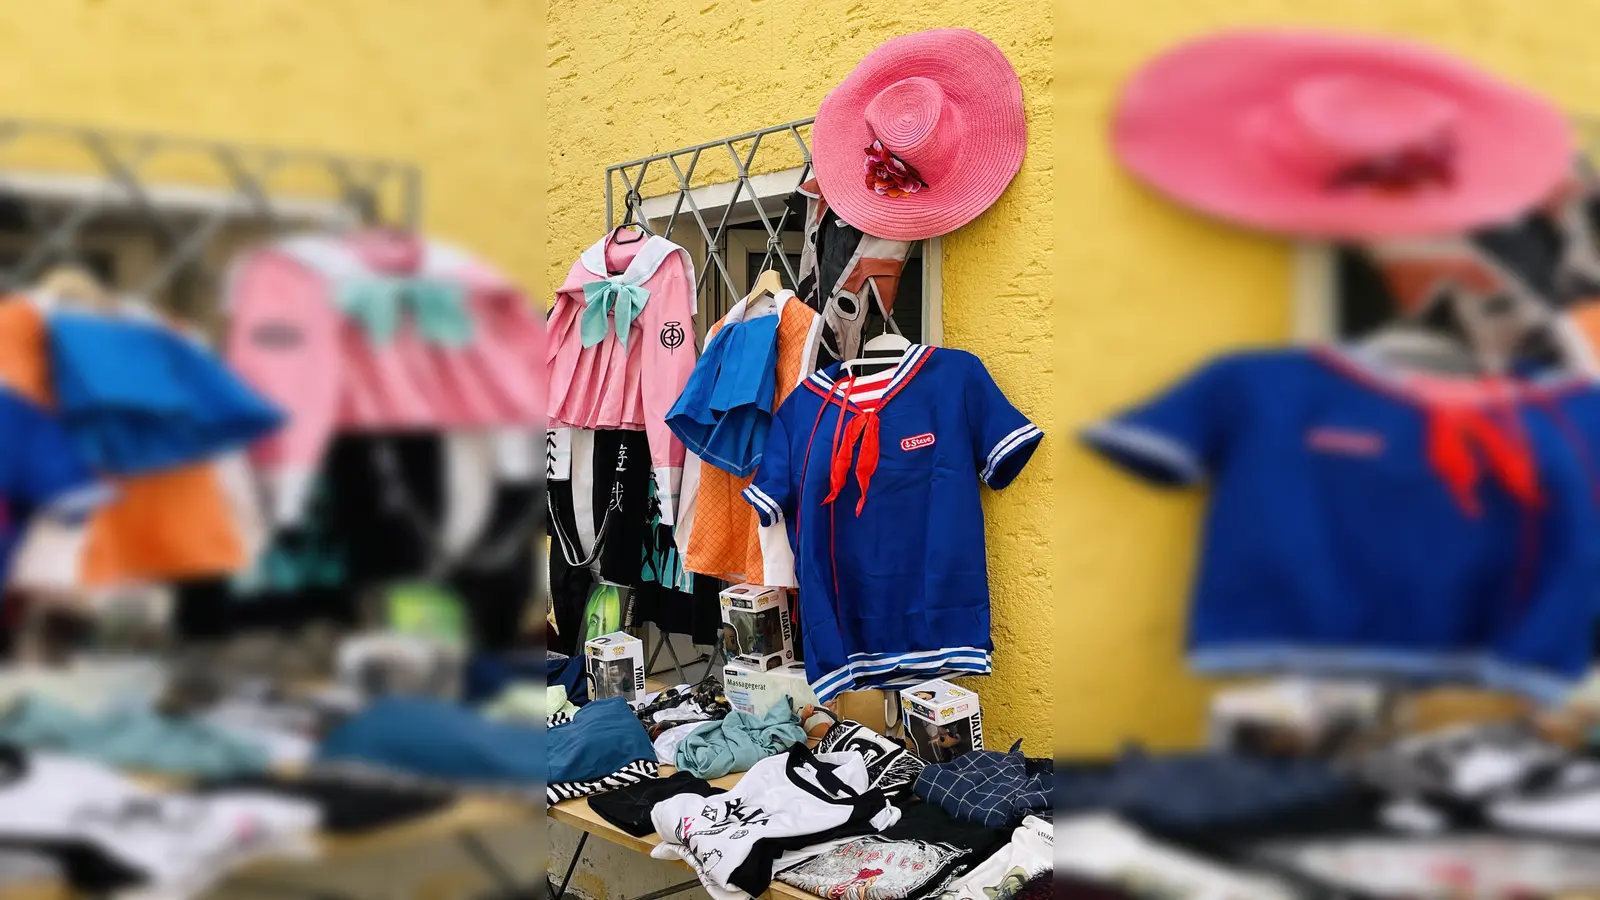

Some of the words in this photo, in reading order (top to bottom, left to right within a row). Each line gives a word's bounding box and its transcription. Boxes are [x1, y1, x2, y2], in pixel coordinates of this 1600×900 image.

[911, 437, 932, 447] Steve
[781, 610, 791, 642] NAKIA
[635, 665, 645, 691] YMIR
[971, 712, 983, 751] VALKY
